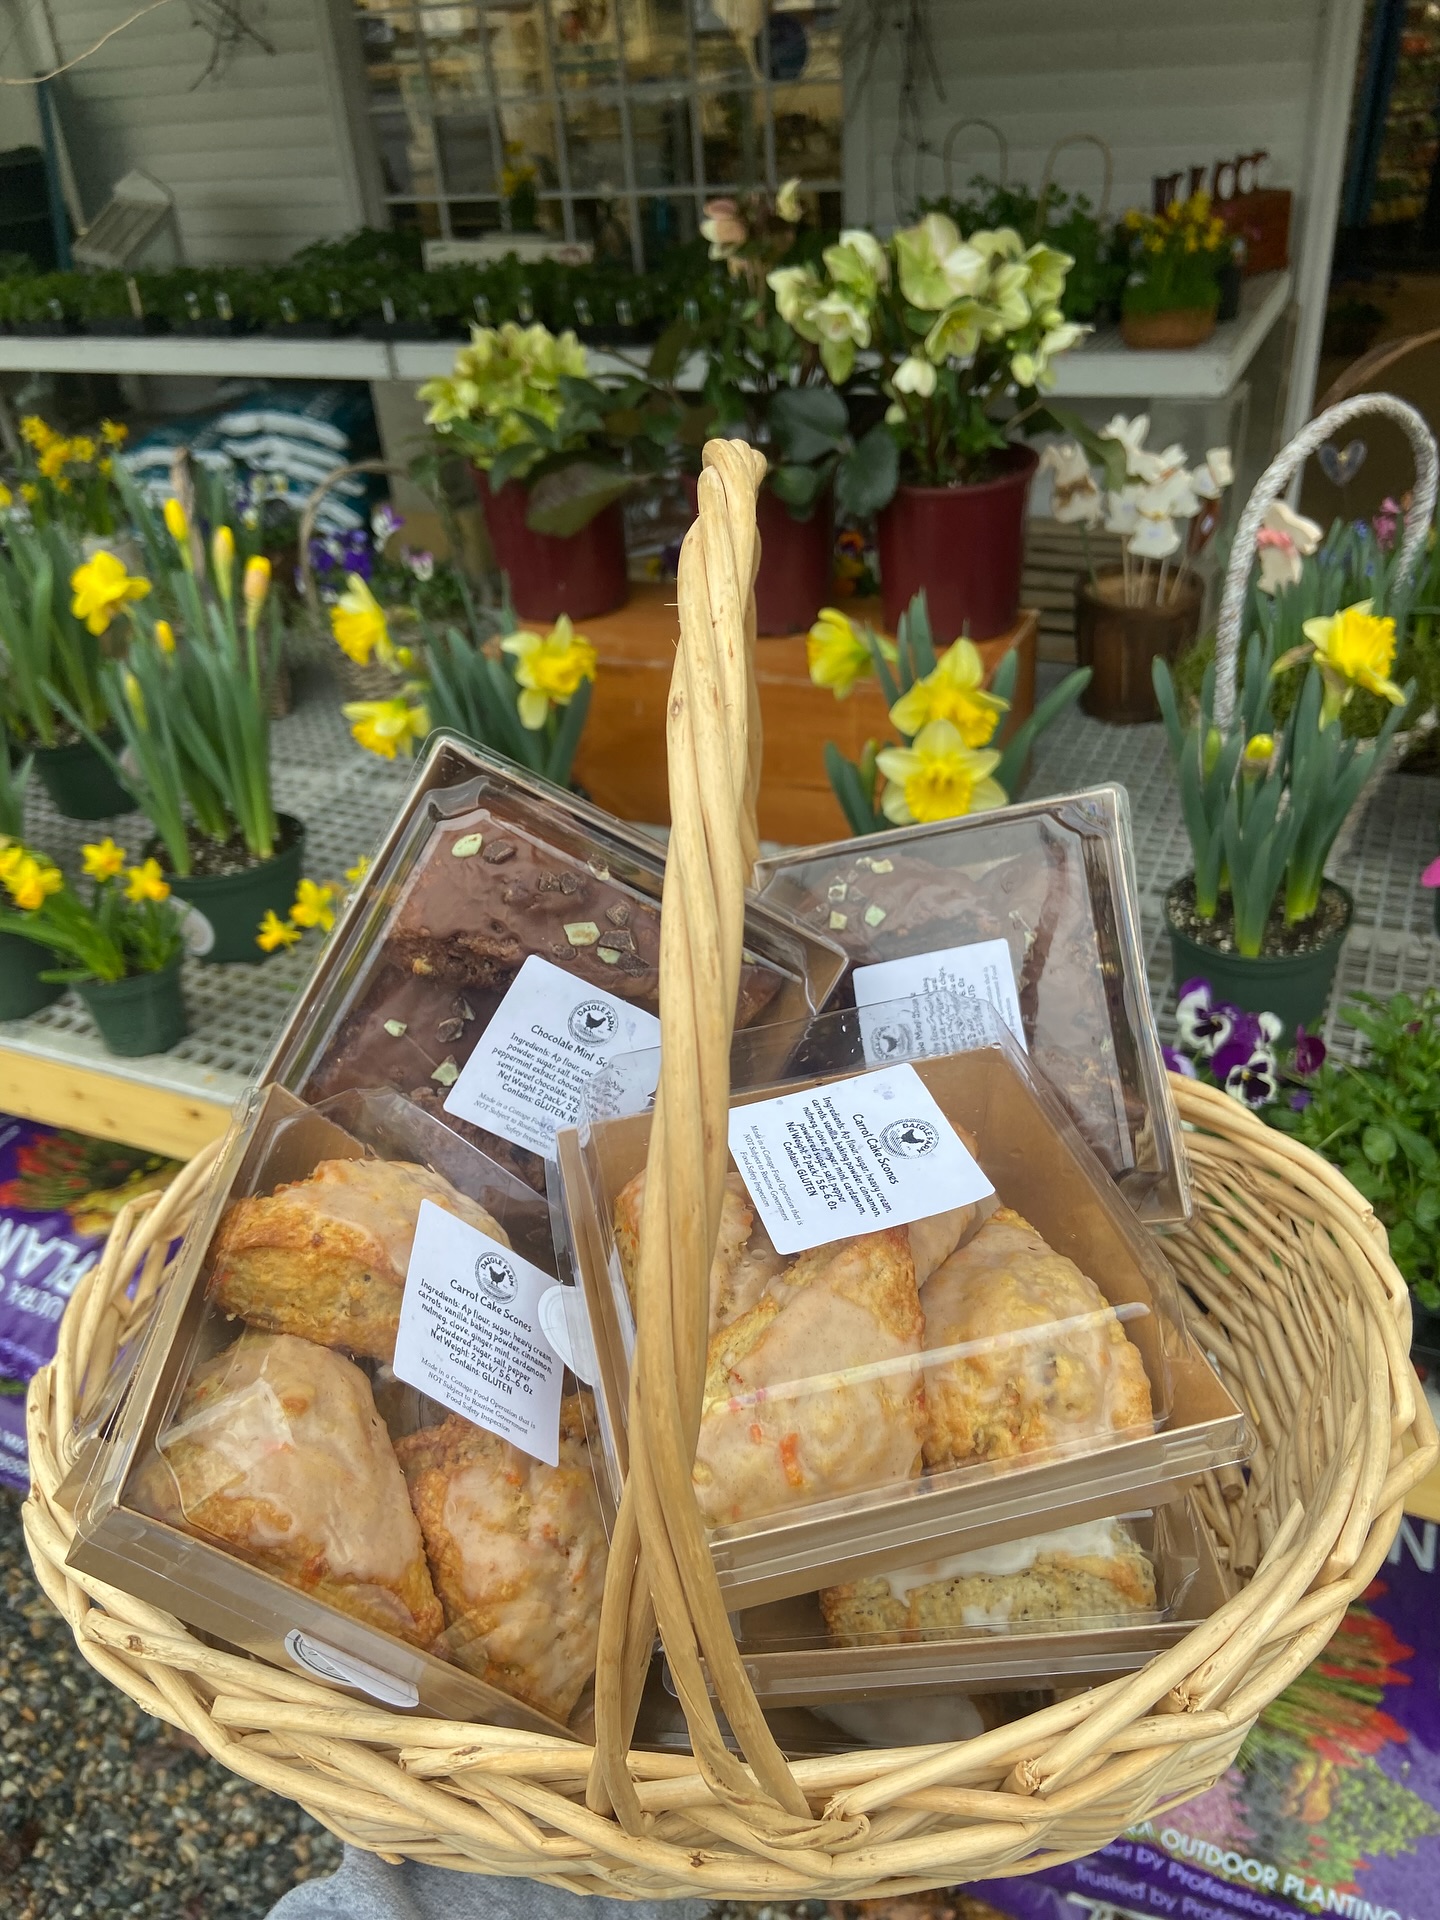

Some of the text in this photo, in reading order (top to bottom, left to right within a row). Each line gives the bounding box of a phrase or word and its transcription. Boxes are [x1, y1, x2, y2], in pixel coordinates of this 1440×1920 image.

[510, 1032, 550, 1057] Ingredients:
[551, 1053, 562, 1063] Ap
[580, 1069, 593, 1077] coc
[531, 1024, 595, 1061] Chocolate Mint
[497, 1069, 512, 1081] Net
[511, 1076, 536, 1093] Weight:
[537, 1088, 544, 1096] 2
[542, 1093, 566, 1106] pack/
[785, 1121, 798, 1133] Net
[791, 1132, 808, 1154] Weight:
[802, 1106, 818, 1129] nutmeg,
[814, 1129, 827, 1147] clove,
[821, 1146, 839, 1167] ginger,
[834, 1166, 849, 1182] mint,
[822, 1096, 845, 1130] Ingredients:
[840, 1131, 850, 1139] Ap
[854, 1155, 869, 1173] sugar,
[876, 1192, 892, 1213] cream,
[852, 1113, 899, 1184] Carrot Cake Scones
[902, 1123, 933, 1153] DAIGLE FARM
[783, 1141, 818, 1196] Contains: GLUTEN
[796, 1123, 846, 1202] powdered sugar, salt, pepper
[803, 1160, 822, 1177] pack/
[811, 1099, 827, 1121] carrots,
[833, 1140, 849, 1162] baking
[843, 1161, 863, 1186] powder,
[859, 1186, 880, 1217] cinnamon,
[418, 1290, 442, 1310] carrots,
[470, 1319, 492, 1340] baking
[493, 1334, 520, 1354] powder,
[521, 1350, 552, 1374] cinnamon,
[420, 1278, 460, 1308] Ingredients:
[461, 1304, 472, 1316] Ap
[492, 1322, 512, 1338] sugar,
[533, 1347, 552, 1364] cream,
[421, 1303, 448, 1325] nutmeg,
[449, 1320, 469, 1336] clove,
[470, 1333, 492, 1350] ginger,
[494, 1346, 510, 1360] mint,
[450, 1279, 531, 1332] Carrot Cake Scones
[430, 1328, 443, 1342] Net
[444, 1336, 469, 1357] Weight:
[470, 1352, 476, 1361] 2
[476, 1357, 498, 1373] pack/
[435, 1323, 530, 1382] powdered sugar, salt, pepper
[449, 1352, 512, 1395] Contains: GLUTEN
[1160, 1827, 1280, 1892] OUTDOOR
